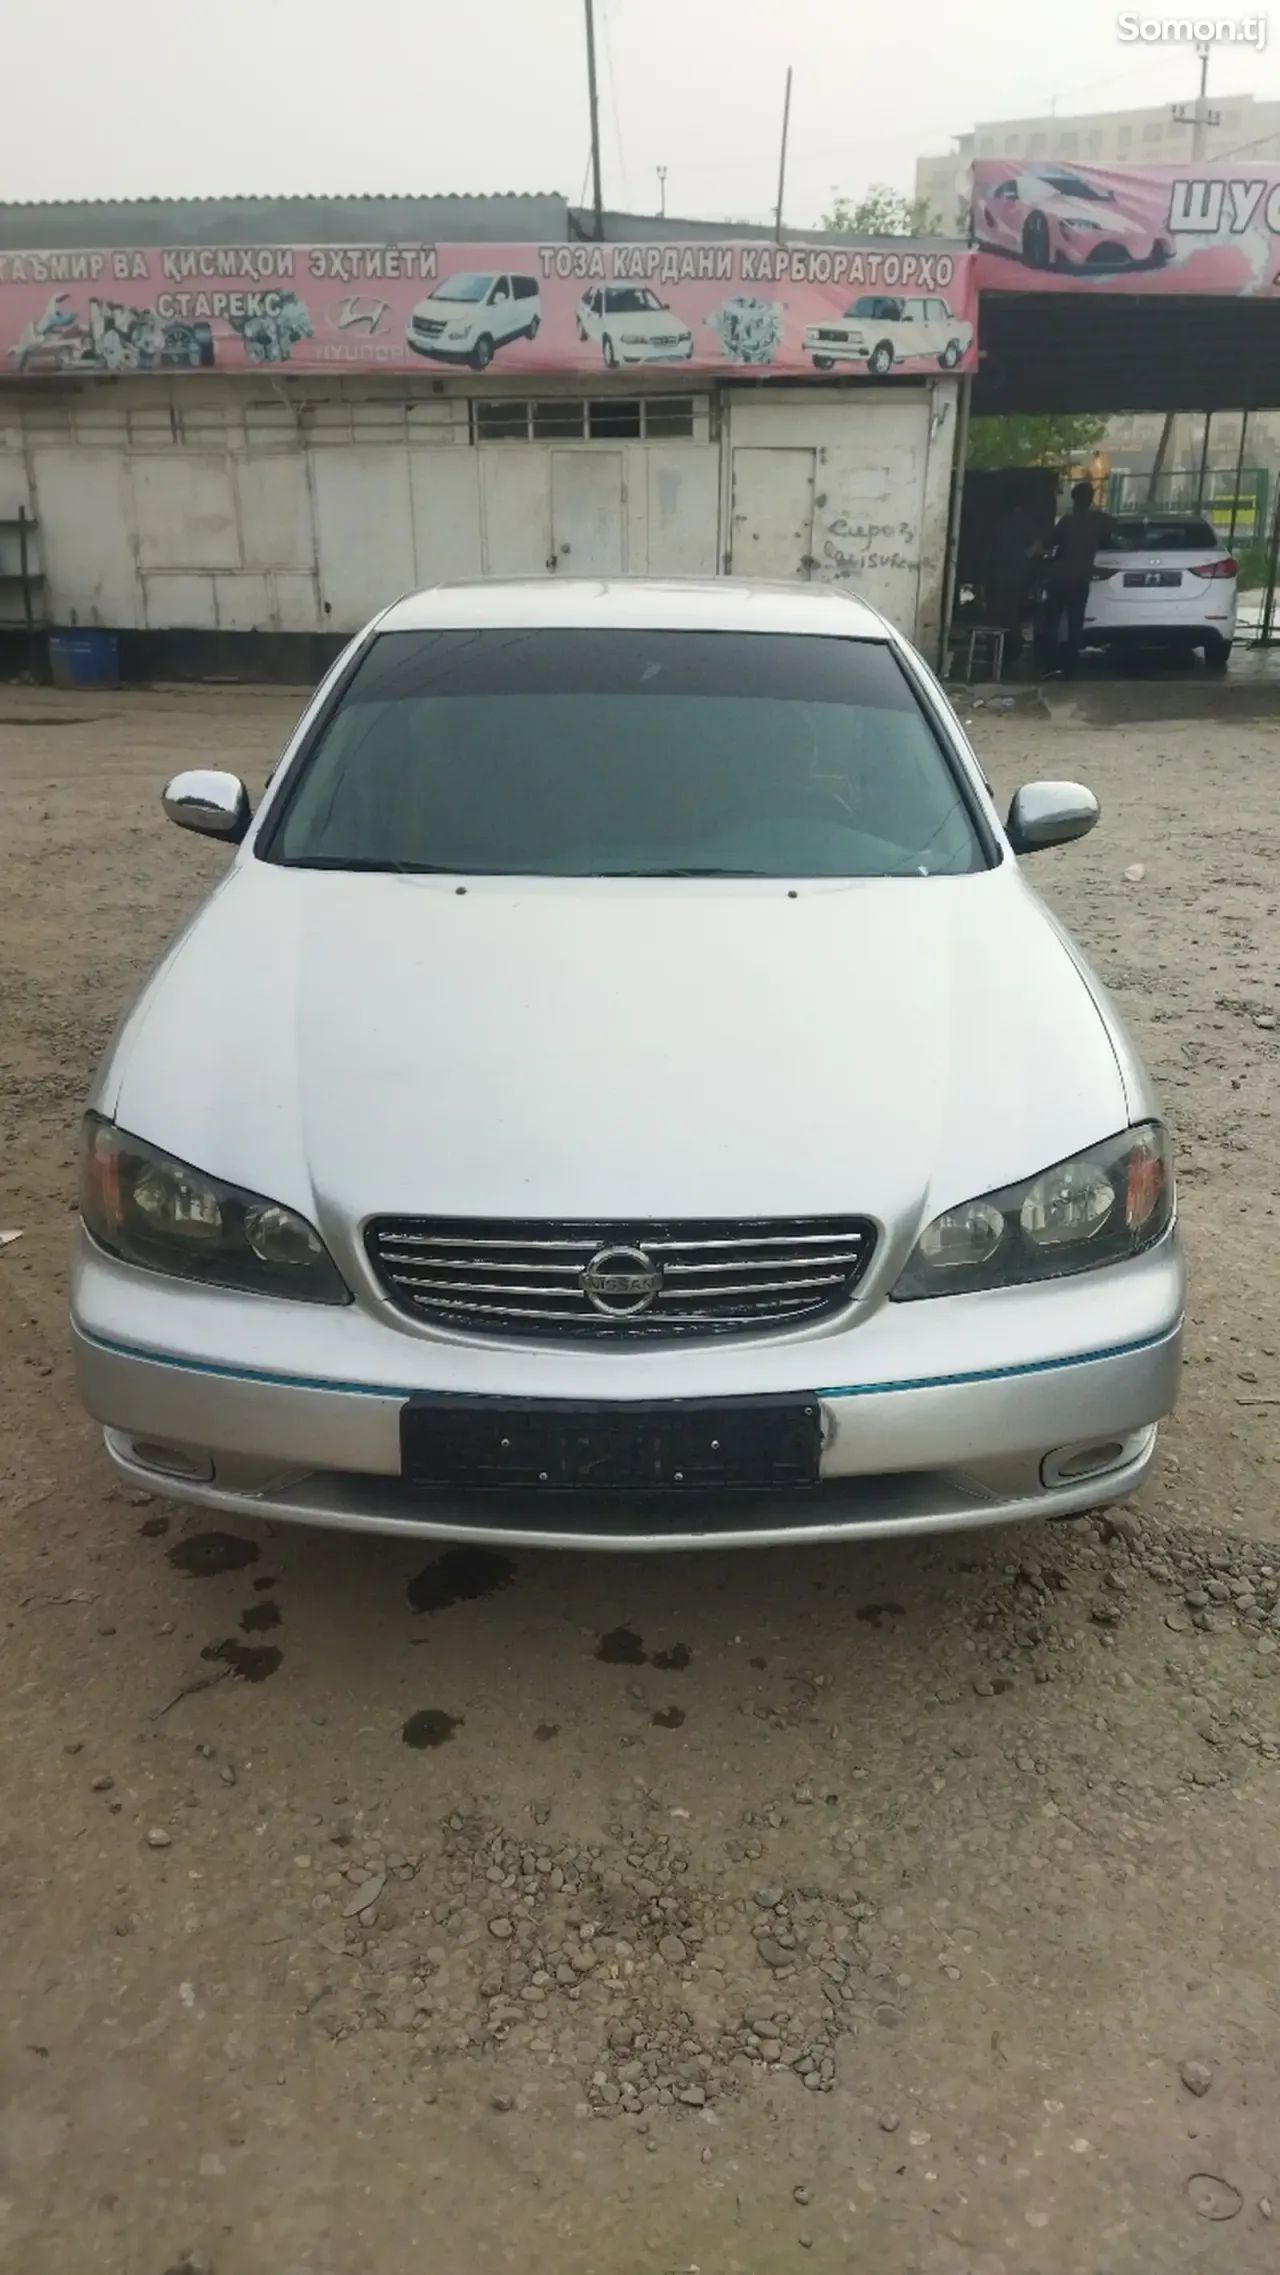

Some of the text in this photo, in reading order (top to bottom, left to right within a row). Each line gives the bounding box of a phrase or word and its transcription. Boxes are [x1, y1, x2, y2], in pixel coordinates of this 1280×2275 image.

[112, 252, 149, 280] ВА
[540, 248, 605, 279] ТОЗА
[612, 247, 733, 285] КАРДАНИ
[157, 291, 282, 319] СТАРЕКС
